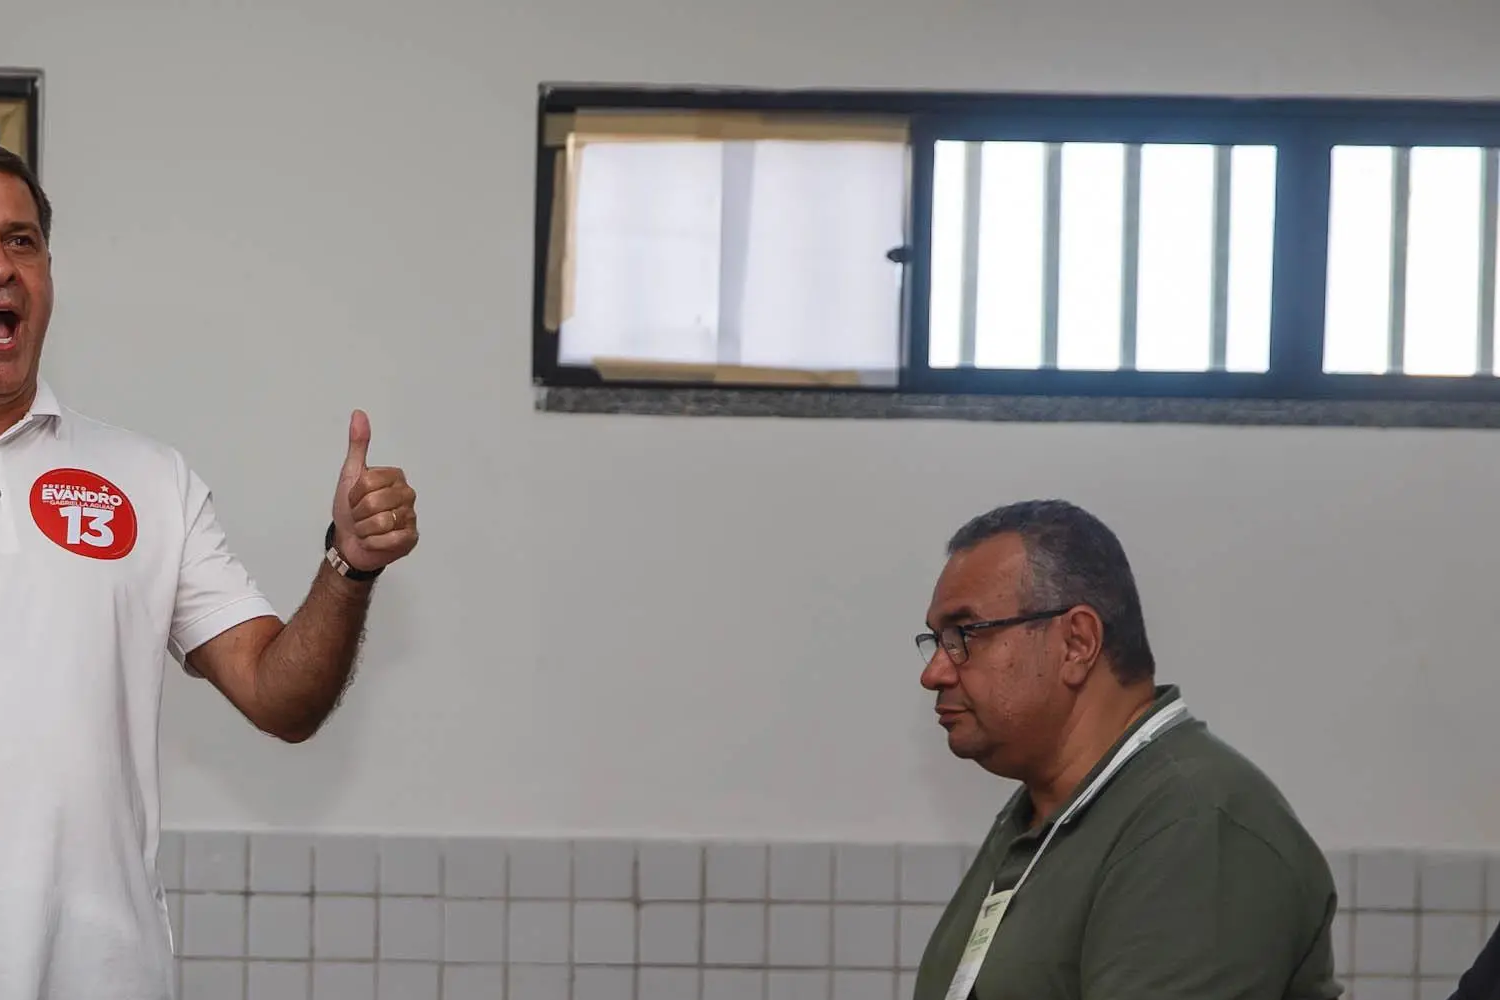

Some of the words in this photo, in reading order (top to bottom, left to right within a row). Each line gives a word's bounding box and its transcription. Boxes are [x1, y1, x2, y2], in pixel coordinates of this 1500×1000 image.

[42, 483, 87, 491] PREFEITO
[41, 488, 123, 507] EVANDRO
[59, 505, 114, 548] 13
